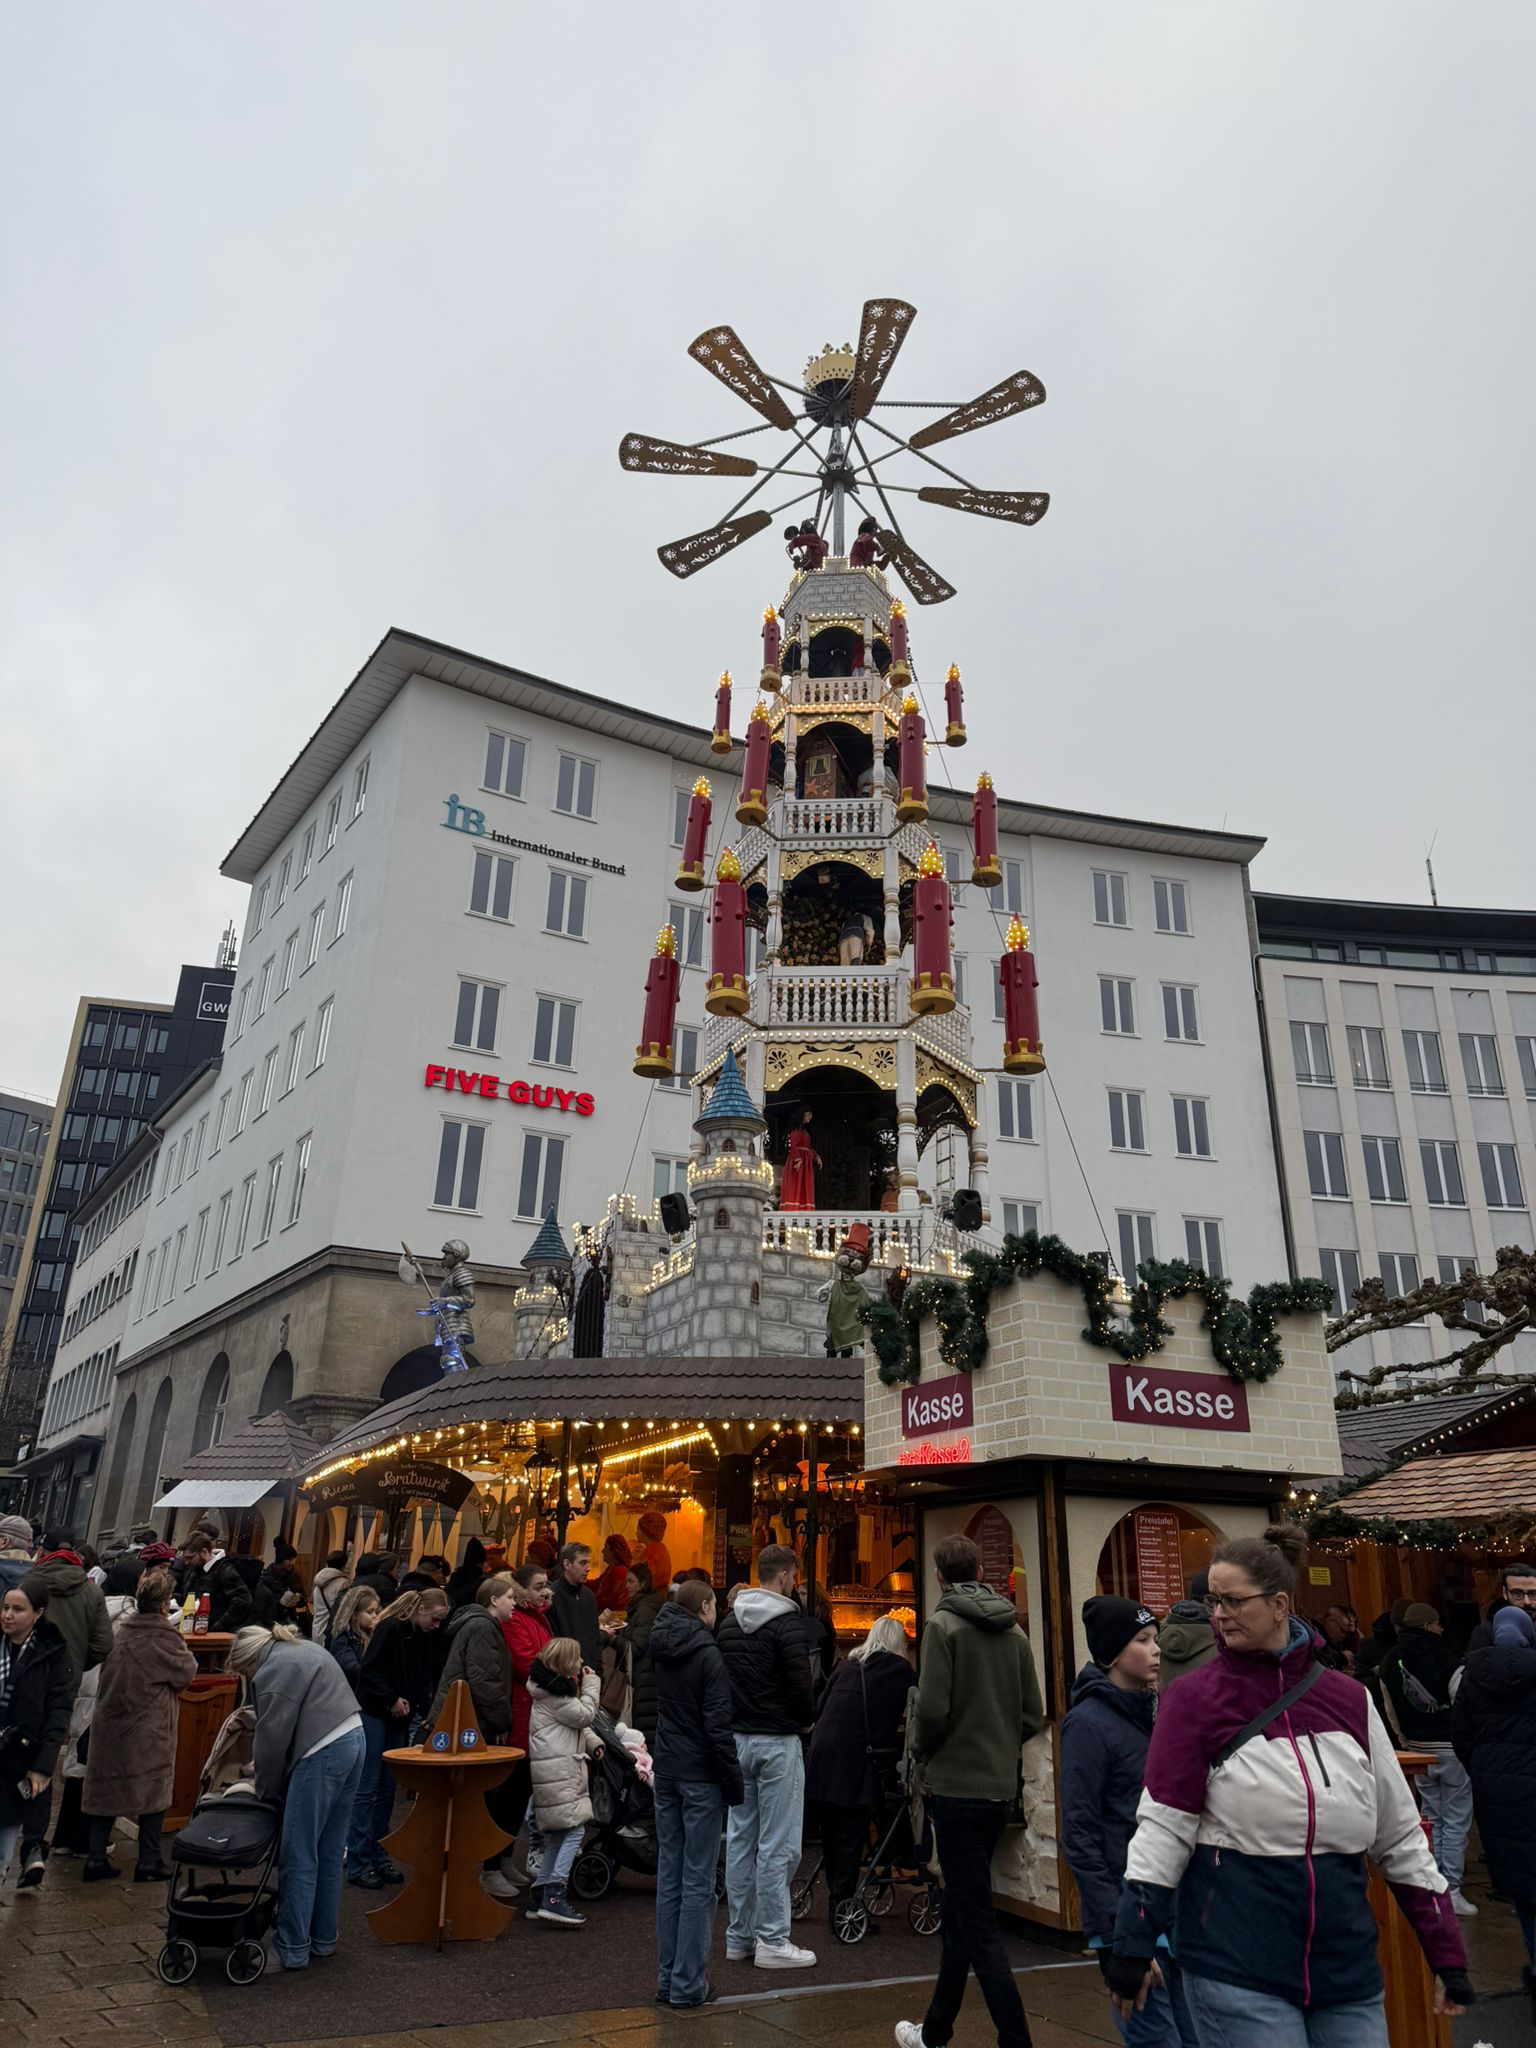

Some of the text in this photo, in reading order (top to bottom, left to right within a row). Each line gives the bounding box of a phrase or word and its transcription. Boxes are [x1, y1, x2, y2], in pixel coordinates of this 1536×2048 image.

[491, 829, 627, 877] Internationaler Bund
[425, 1064, 595, 1116] FIVE GUYS
[907, 1392, 964, 1429] Kasse
[1125, 1375, 1236, 1420] Kasse
[921, 1441, 959, 1464] Kasse
[321, 1483, 356, 1500] Riesen
[378, 1470, 451, 1493] Bratwurst
[1139, 1515, 1174, 1525] Preistafel
